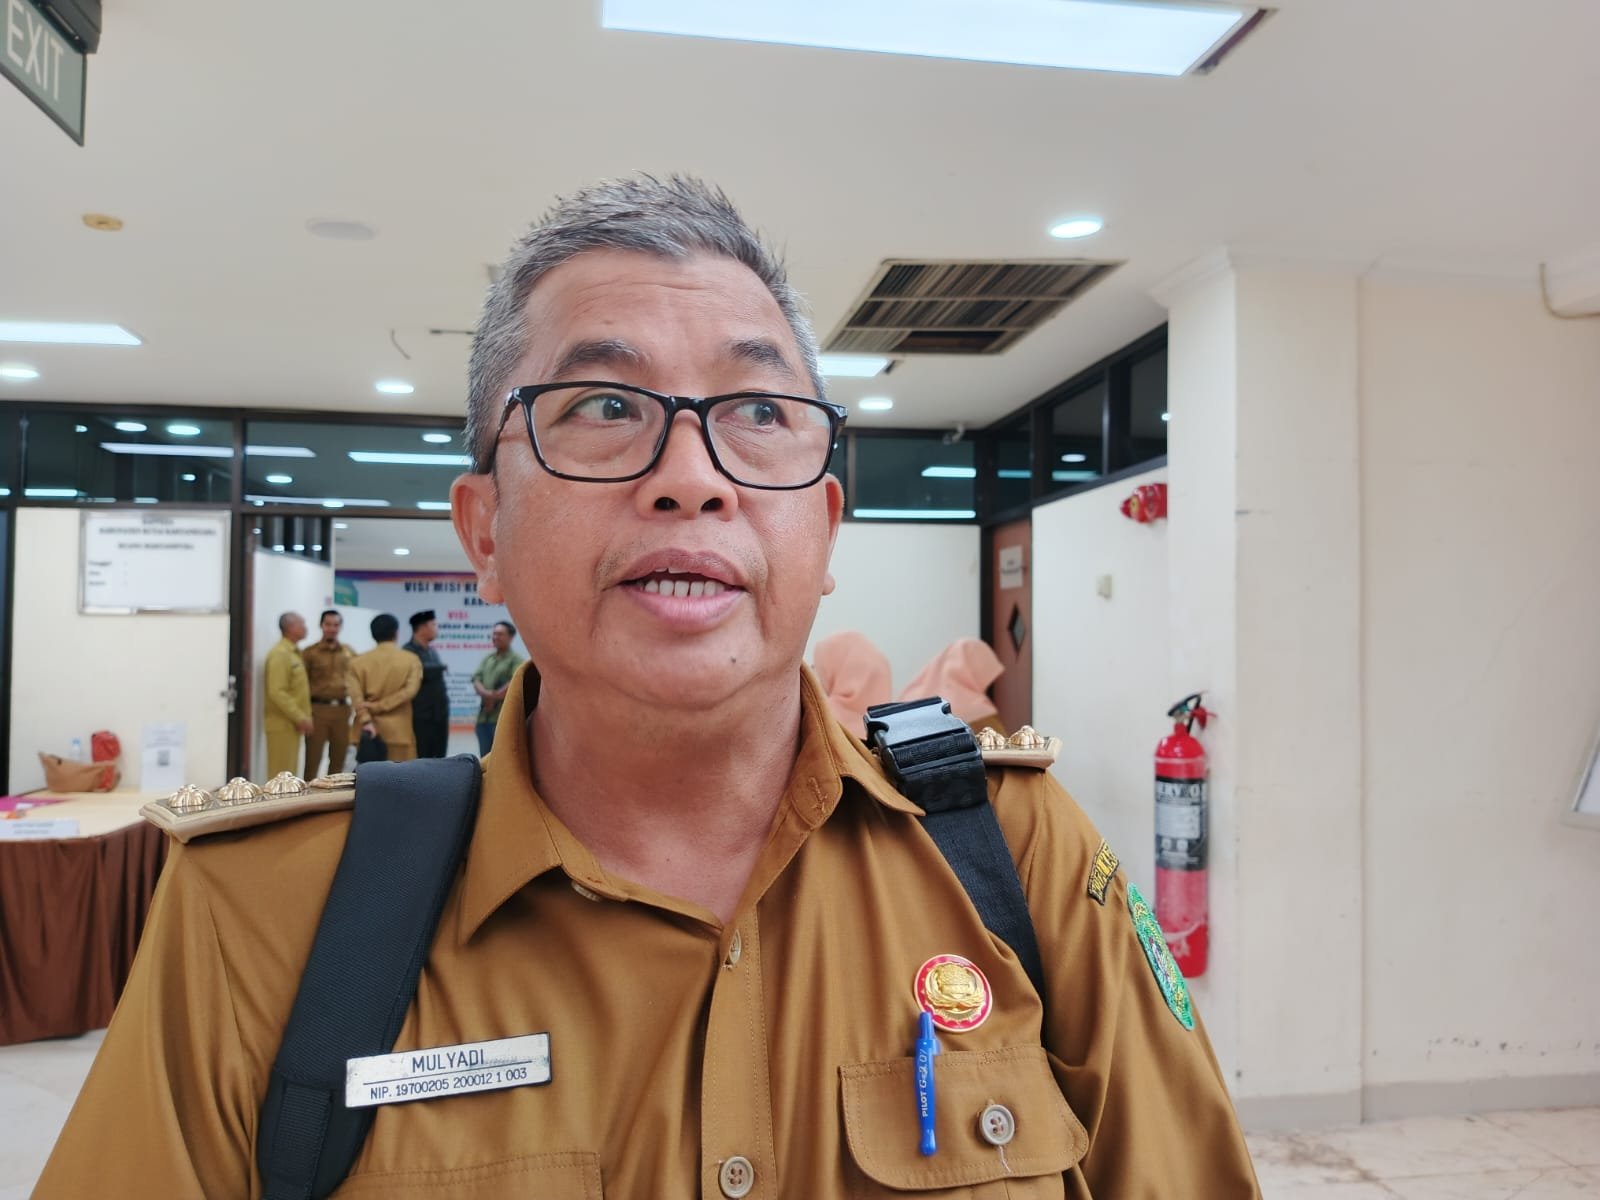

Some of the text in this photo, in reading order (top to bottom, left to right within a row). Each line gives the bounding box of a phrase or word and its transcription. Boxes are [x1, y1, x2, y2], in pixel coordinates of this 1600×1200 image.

[6, 0, 65, 102] EXIT
[404, 582, 429, 592] VISI
[433, 582, 461, 592] MISI
[448, 610, 469, 620] VISI
[412, 1048, 485, 1073] MULYADI
[370, 1067, 527, 1100] NIP. 19700205 200012 1 003
[920, 1091, 928, 1118] PILOT
